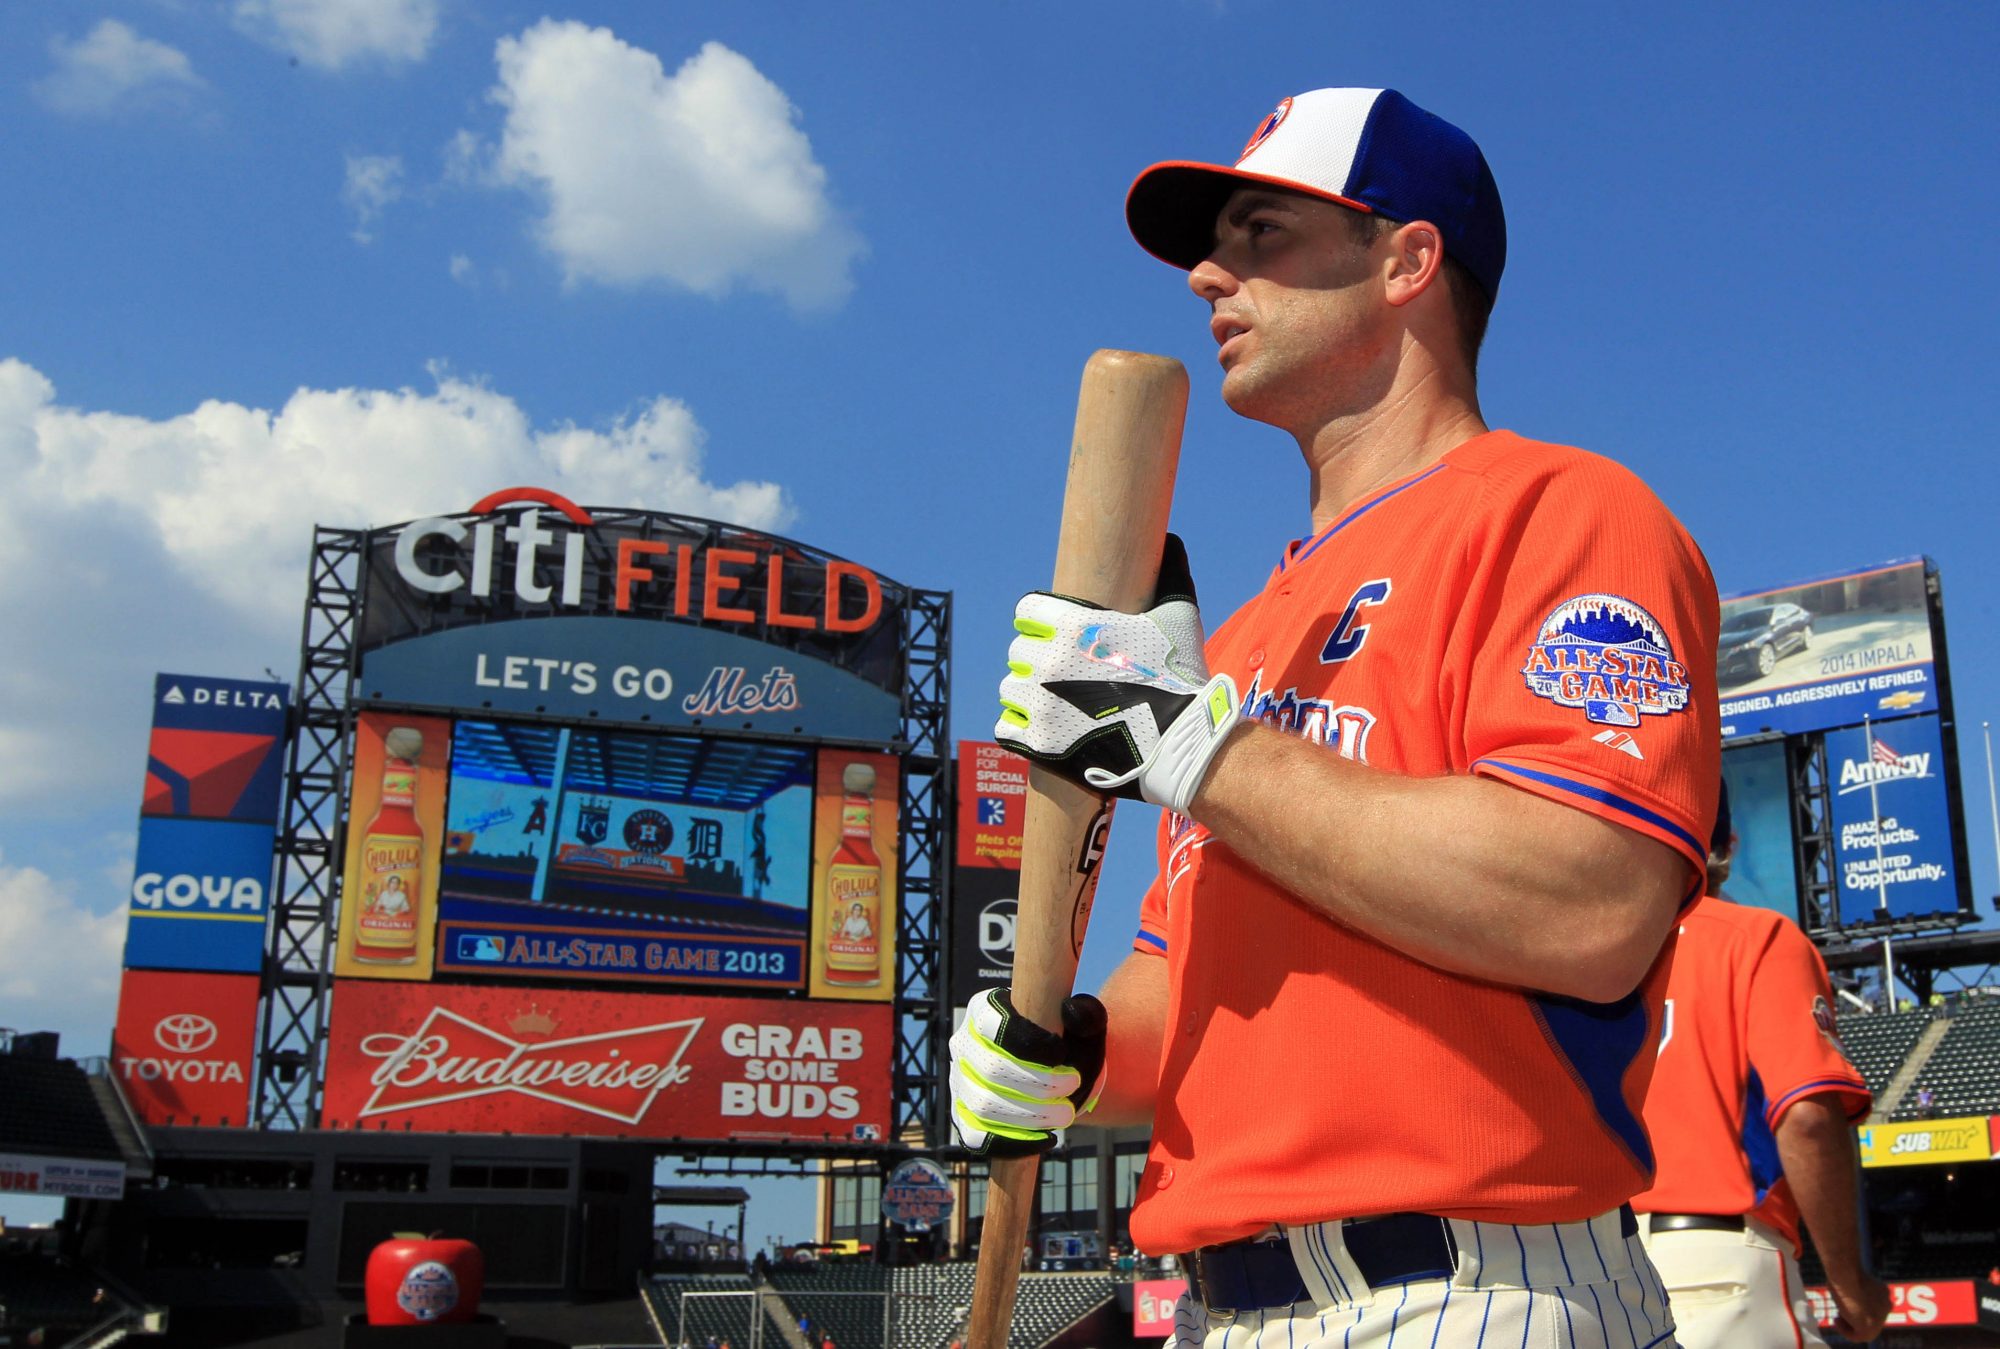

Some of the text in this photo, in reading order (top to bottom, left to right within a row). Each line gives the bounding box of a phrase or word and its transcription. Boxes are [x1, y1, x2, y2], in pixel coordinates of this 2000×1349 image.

[615, 538, 883, 632] FIELD
[1319, 578, 1392, 665] C
[1820, 643, 1916, 675] 2014 IMPALA
[193, 687, 282, 710] DELTA
[476, 654, 801, 716] LET'S GO Mets
[1559, 673, 1663, 708] GAME
[1775, 679, 1867, 707] AGGRESSIVELY
[1869, 669, 1928, 690] REFINED.
[976, 758, 999, 769] FOR
[976, 770, 1025, 783] SPECIAL
[1840, 753, 1931, 786] Amway
[976, 782, 1027, 795] SURGER
[976, 834, 1005, 846] Mets
[1842, 817, 1898, 836] AMAZNG
[1842, 828, 1920, 851] Products.
[976, 846, 1024, 859] Hospita
[1844, 855, 1912, 874] UNLIMITED
[1845, 863, 1947, 891] Opportunity.
[133, 873, 264, 911] GOYA
[645, 943, 721, 971] GAME
[724, 951, 785, 974] 2013
[721, 1023, 863, 1060] GRAB
[121, 1056, 243, 1083] TOYOTA
[360, 1033, 690, 1090] Budweiser
[744, 1059, 838, 1083] SOME
[720, 1083, 860, 1119] BUDS
[1890, 1126, 1978, 1154] SUBWAY
